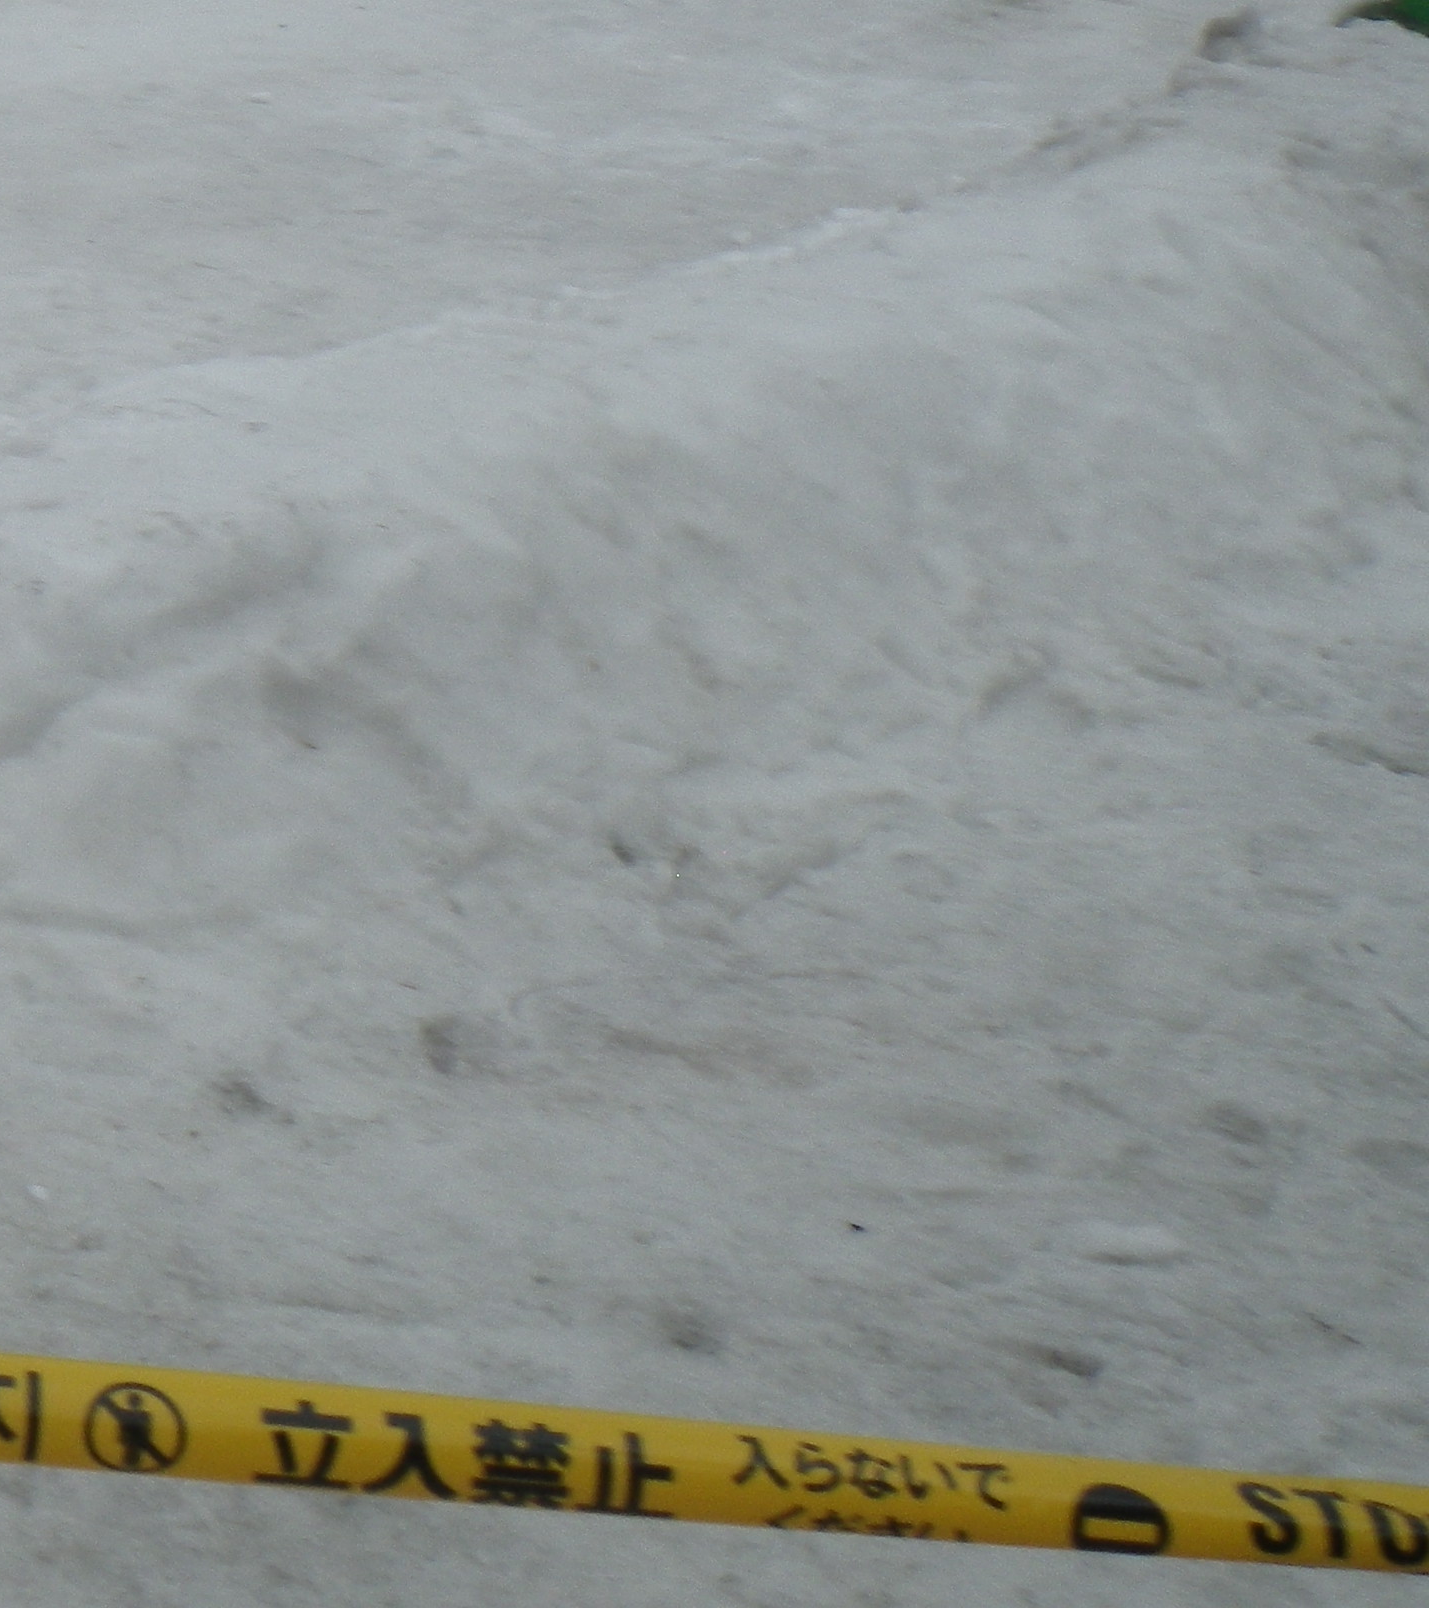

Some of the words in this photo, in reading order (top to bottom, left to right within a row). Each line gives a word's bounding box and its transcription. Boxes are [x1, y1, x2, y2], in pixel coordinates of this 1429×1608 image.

[253, 1399, 675, 1520] 立入禁止
[731, 1434, 1016, 1512] 入らないで
[1237, 1481, 1429, 1566] STO
